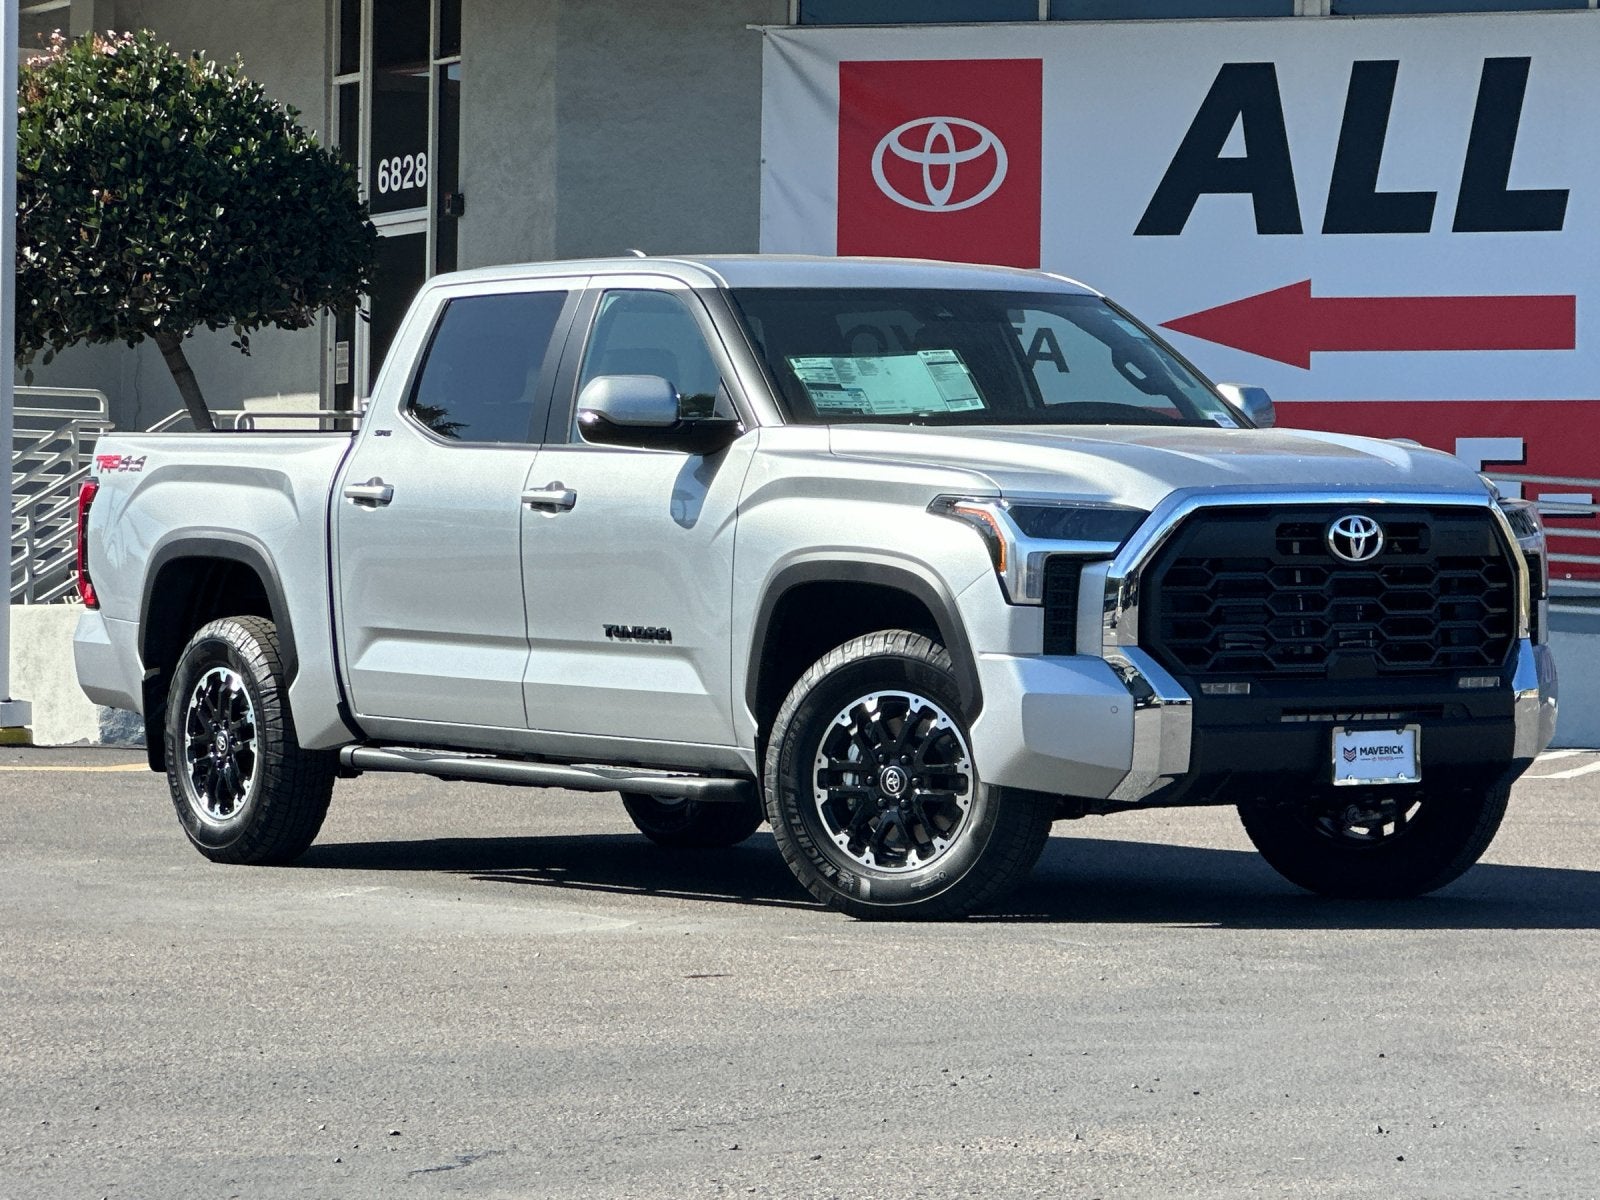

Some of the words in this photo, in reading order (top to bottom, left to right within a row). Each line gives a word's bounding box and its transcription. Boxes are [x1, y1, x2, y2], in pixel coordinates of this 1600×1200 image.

[378, 152, 427, 194] 6828
[1133, 56, 1569, 235] ALL
[1360, 745, 1404, 756] MAVERICK
[787, 791, 836, 877] MICHELIN
